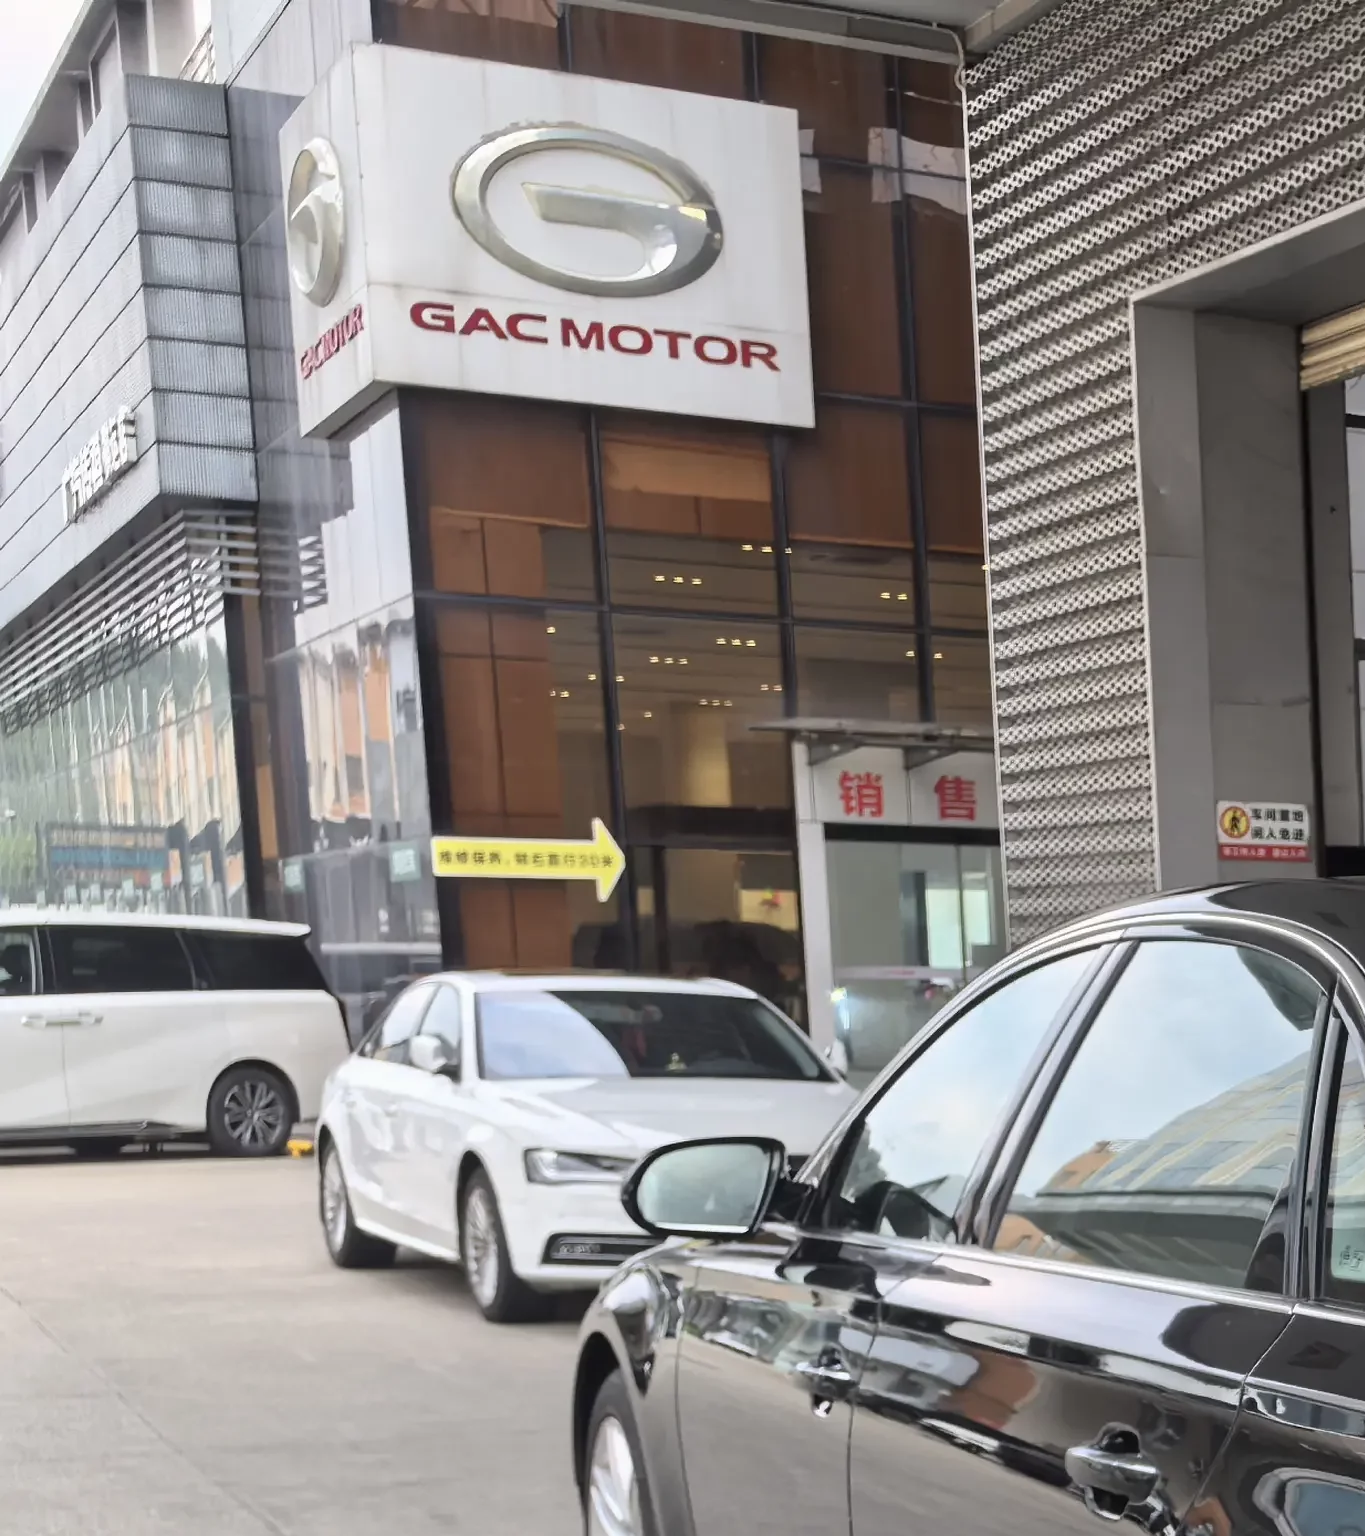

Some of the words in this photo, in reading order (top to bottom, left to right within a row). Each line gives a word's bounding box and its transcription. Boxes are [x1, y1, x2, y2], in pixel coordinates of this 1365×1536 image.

[410, 301, 549, 344] GAC
[560, 317, 782, 373] MOTOR
[839, 770, 977, 820] 销售
